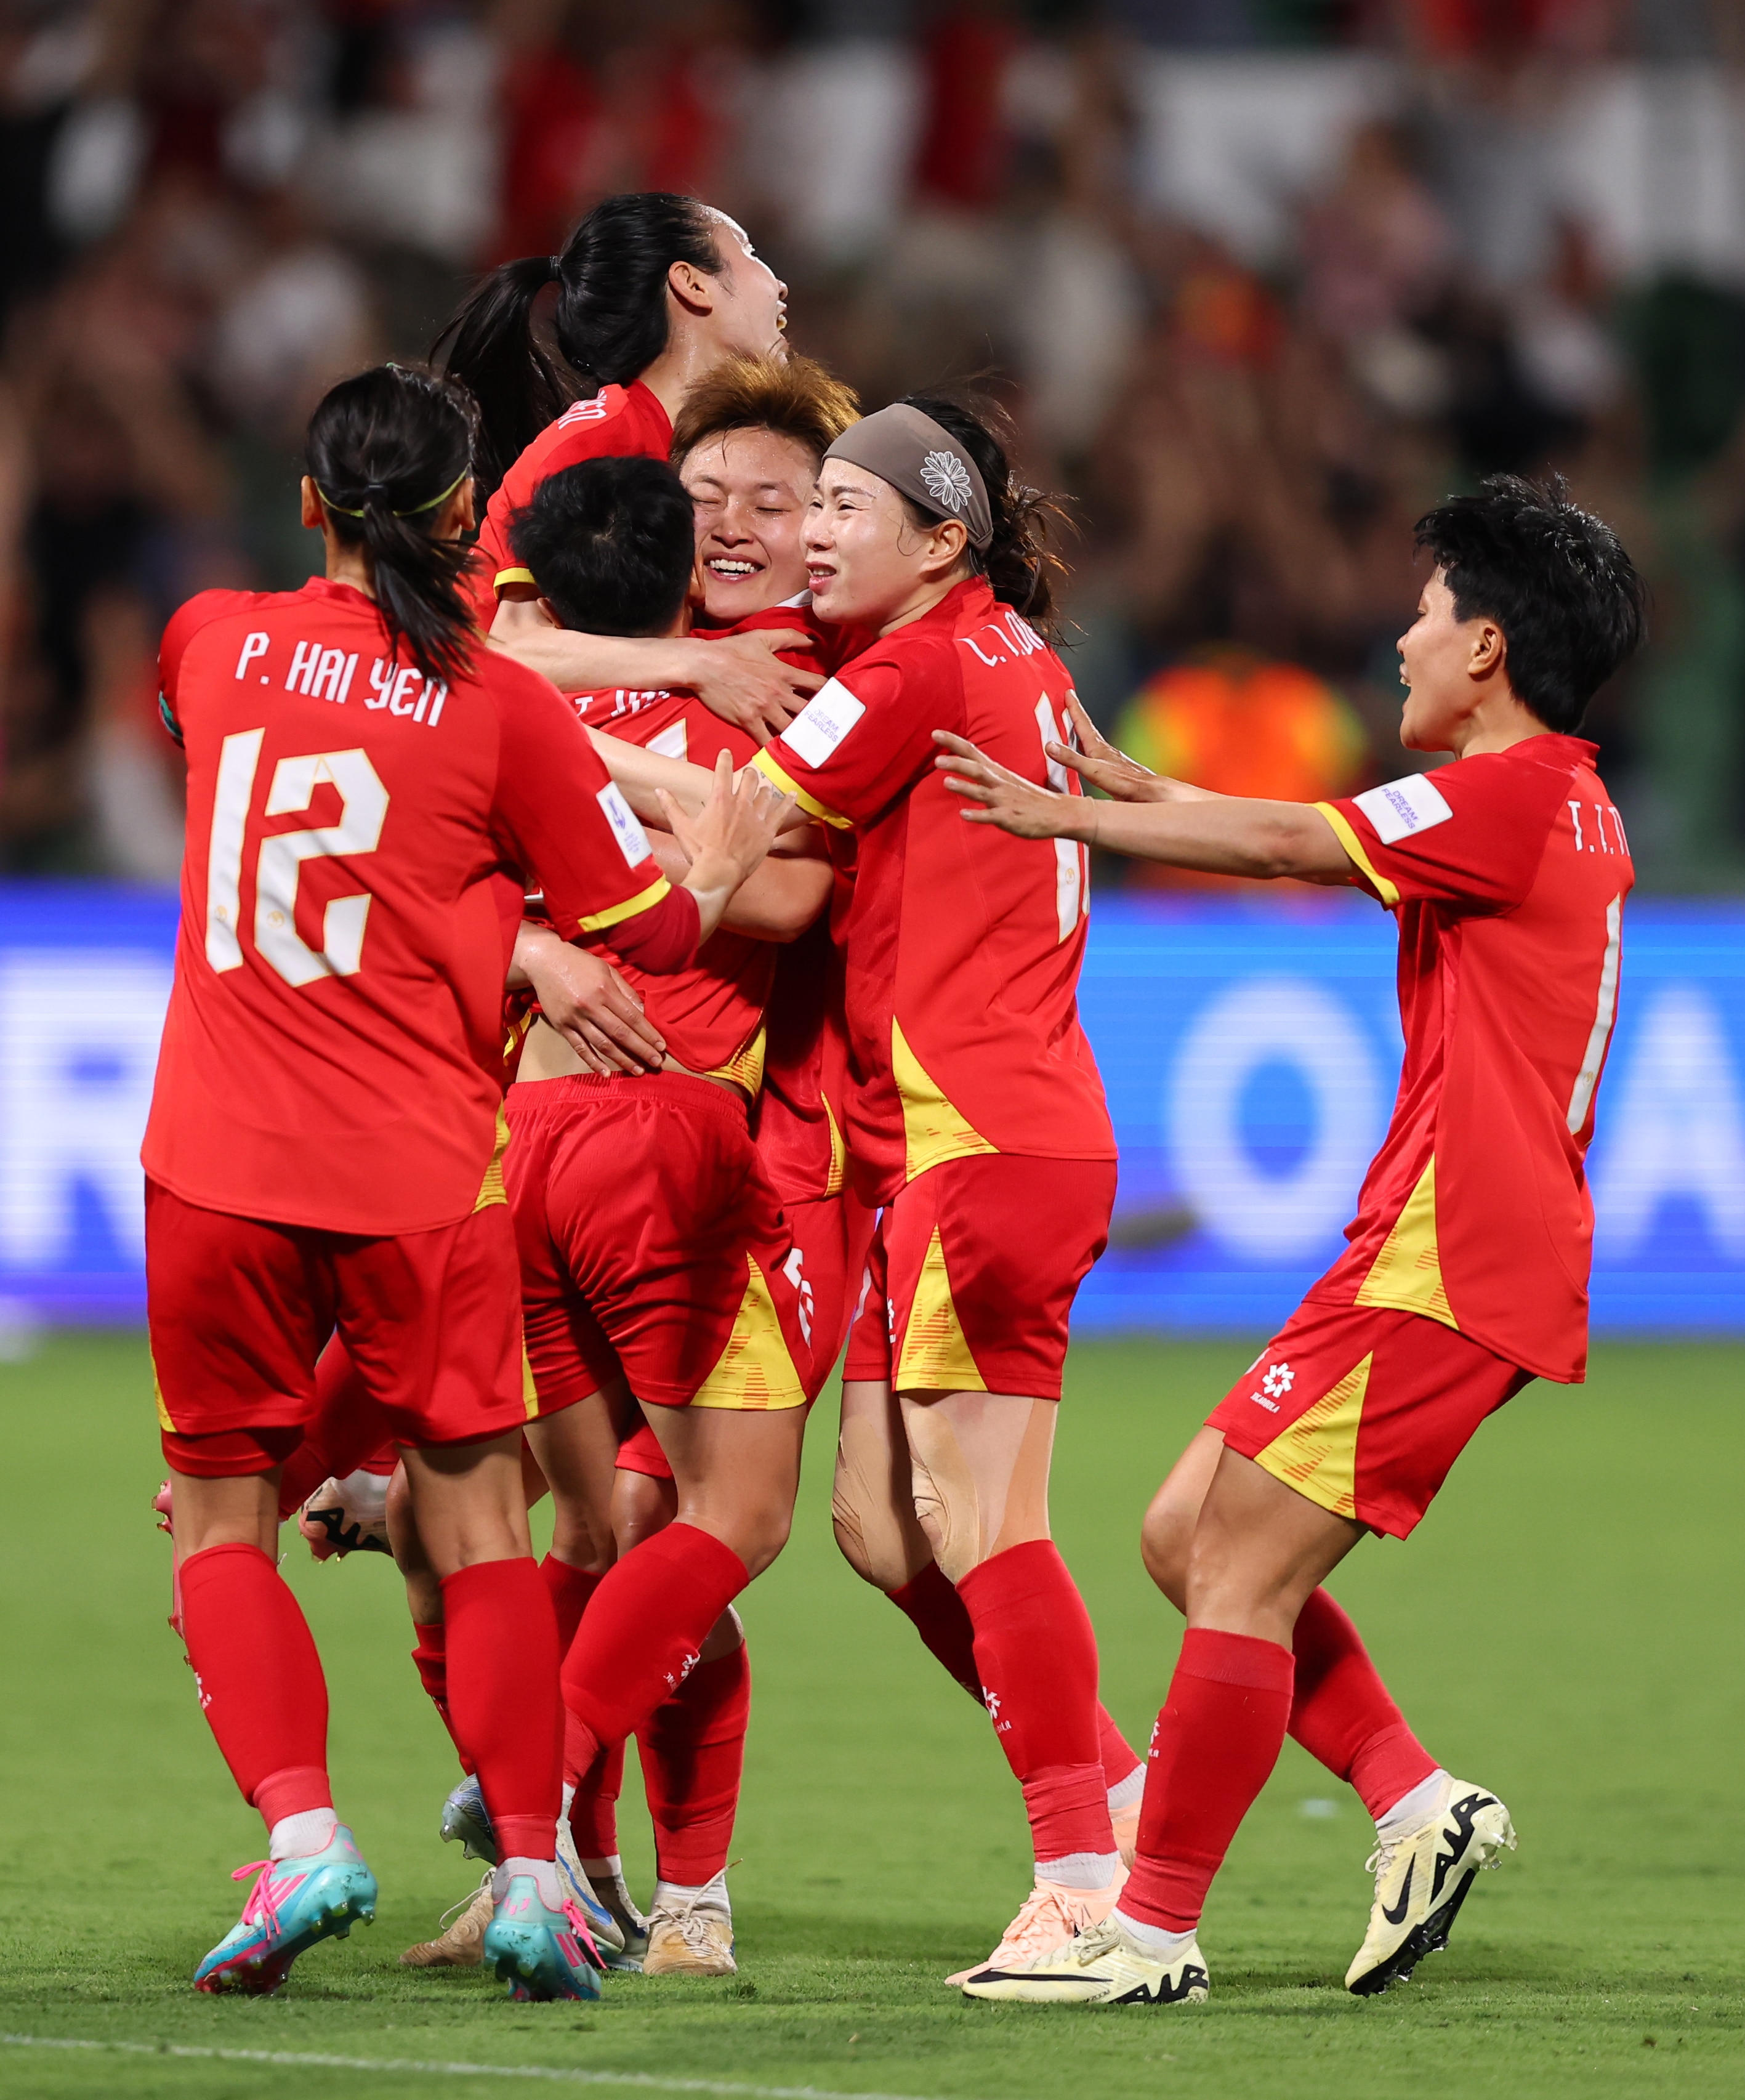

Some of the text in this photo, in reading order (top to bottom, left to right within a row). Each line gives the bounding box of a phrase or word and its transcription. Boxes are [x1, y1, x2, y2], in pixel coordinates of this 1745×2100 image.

[235, 632, 448, 727] P. HAI YEN
[804, 710, 839, 742] FEARLESS
[814, 709, 839, 732] DREAM
[1382, 788, 1416, 829] FEARLESS
[1393, 790, 1418, 820] DREAM
[206, 727, 390, 987] 12
